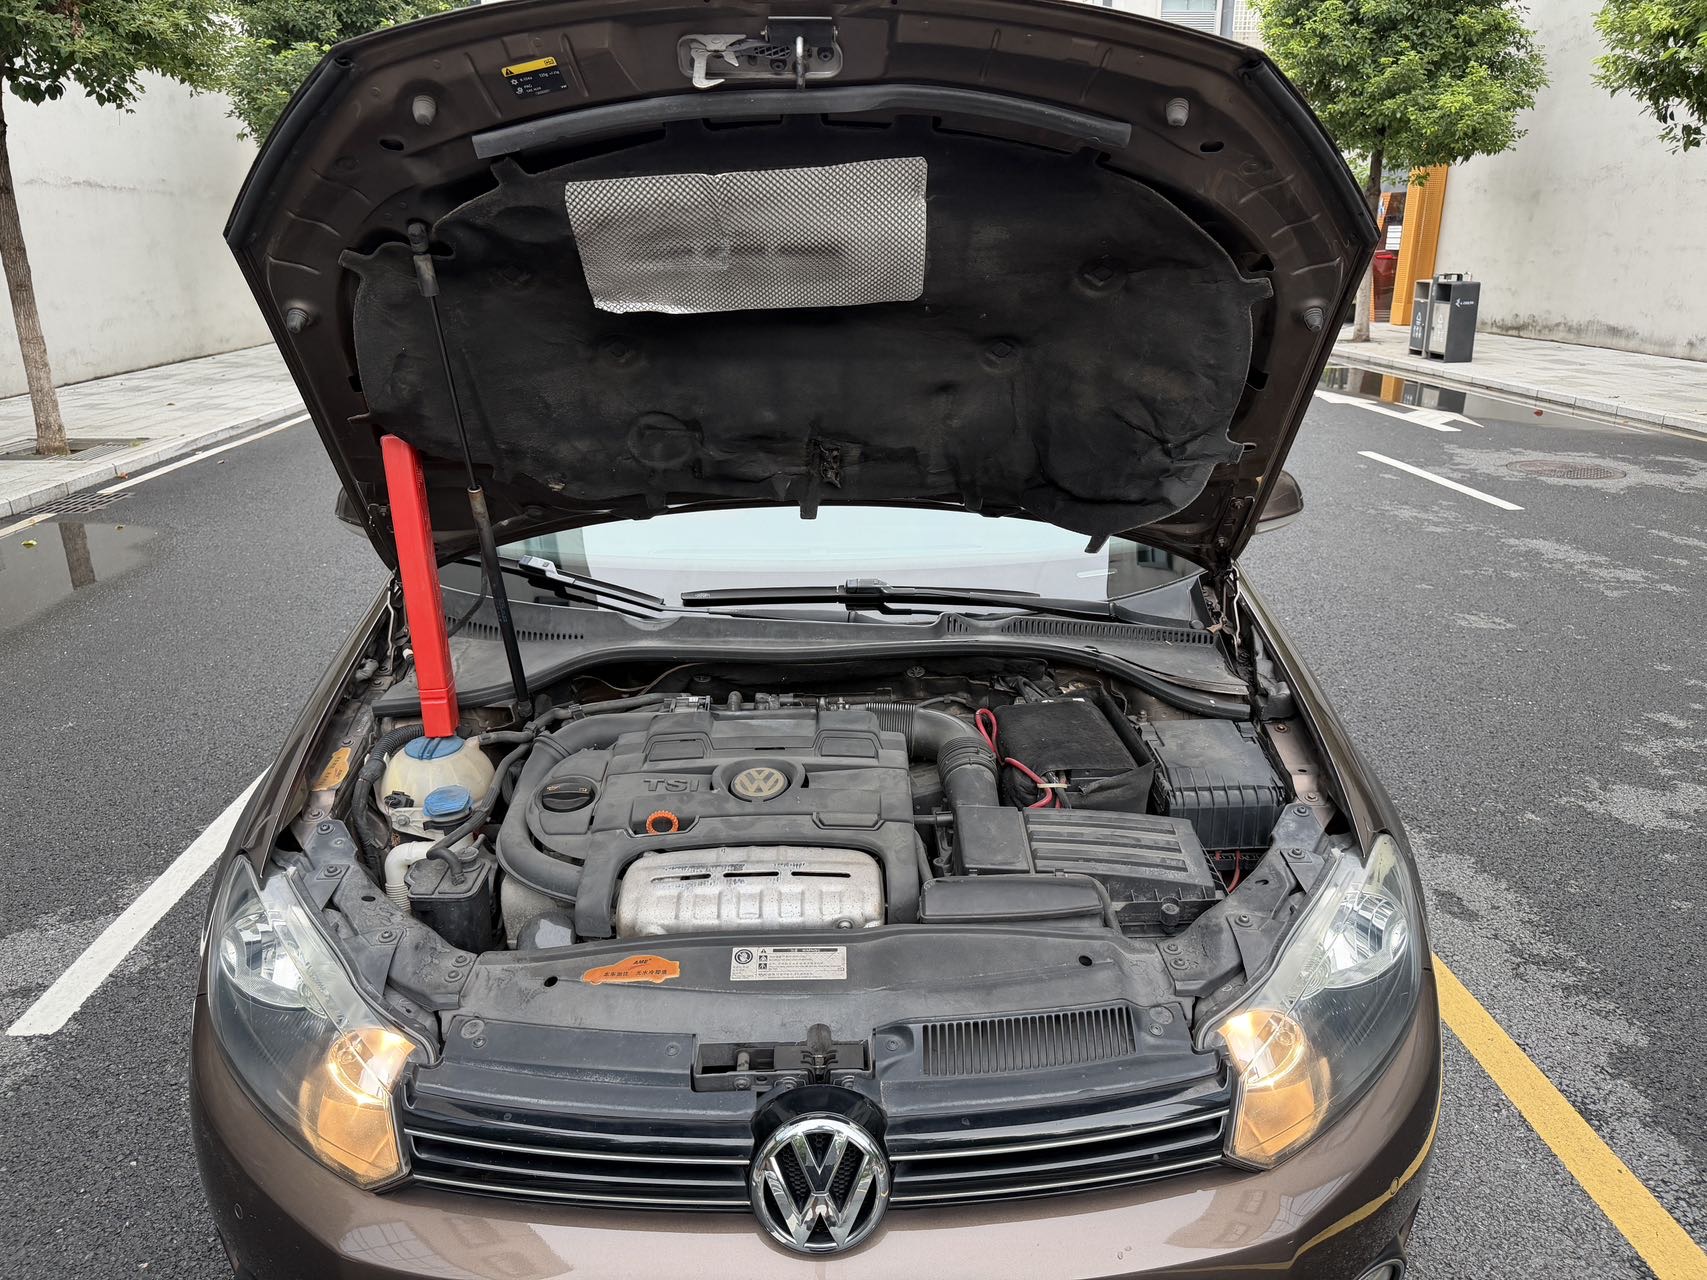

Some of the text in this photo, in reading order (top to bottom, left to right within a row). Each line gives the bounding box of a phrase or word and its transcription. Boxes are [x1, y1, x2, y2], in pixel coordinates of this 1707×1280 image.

[643, 779, 699, 792] TSI
[734, 767, 785, 797] VW
[755, 1118, 886, 1251] VW
